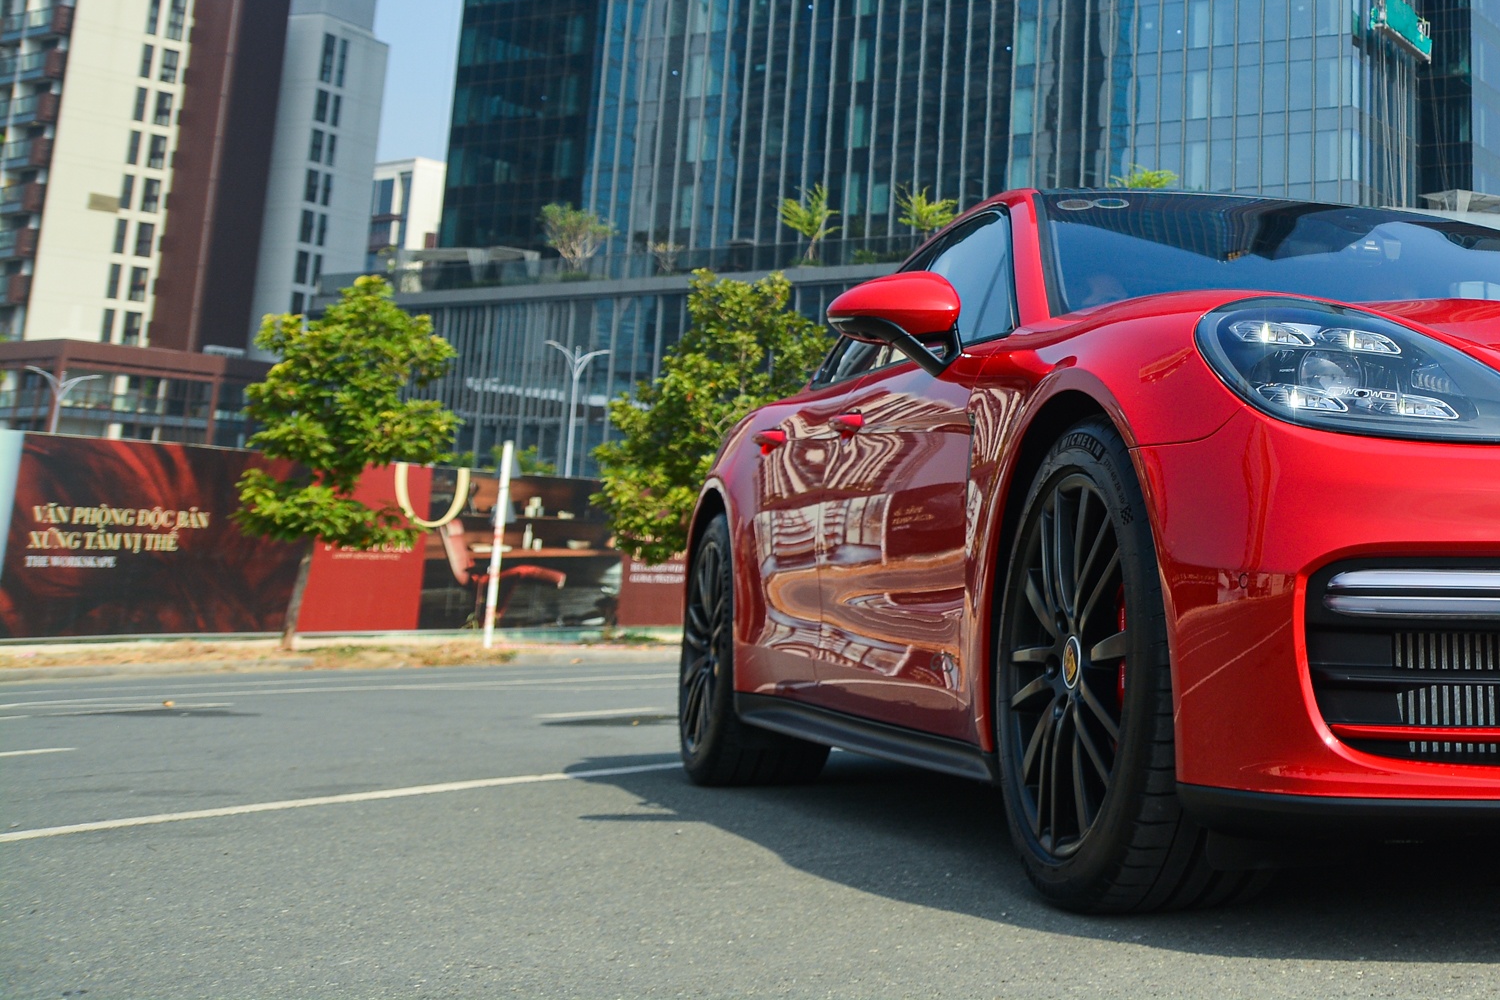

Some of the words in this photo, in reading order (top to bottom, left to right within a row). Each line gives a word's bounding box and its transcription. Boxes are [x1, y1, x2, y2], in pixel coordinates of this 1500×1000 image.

[1060, 433, 1104, 458] MICHELIN
[33, 502, 71, 523] VĂN
[136, 506, 176, 530] ĐỘC
[123, 532, 142, 553] VỊ
[25, 556, 49, 568] THE
